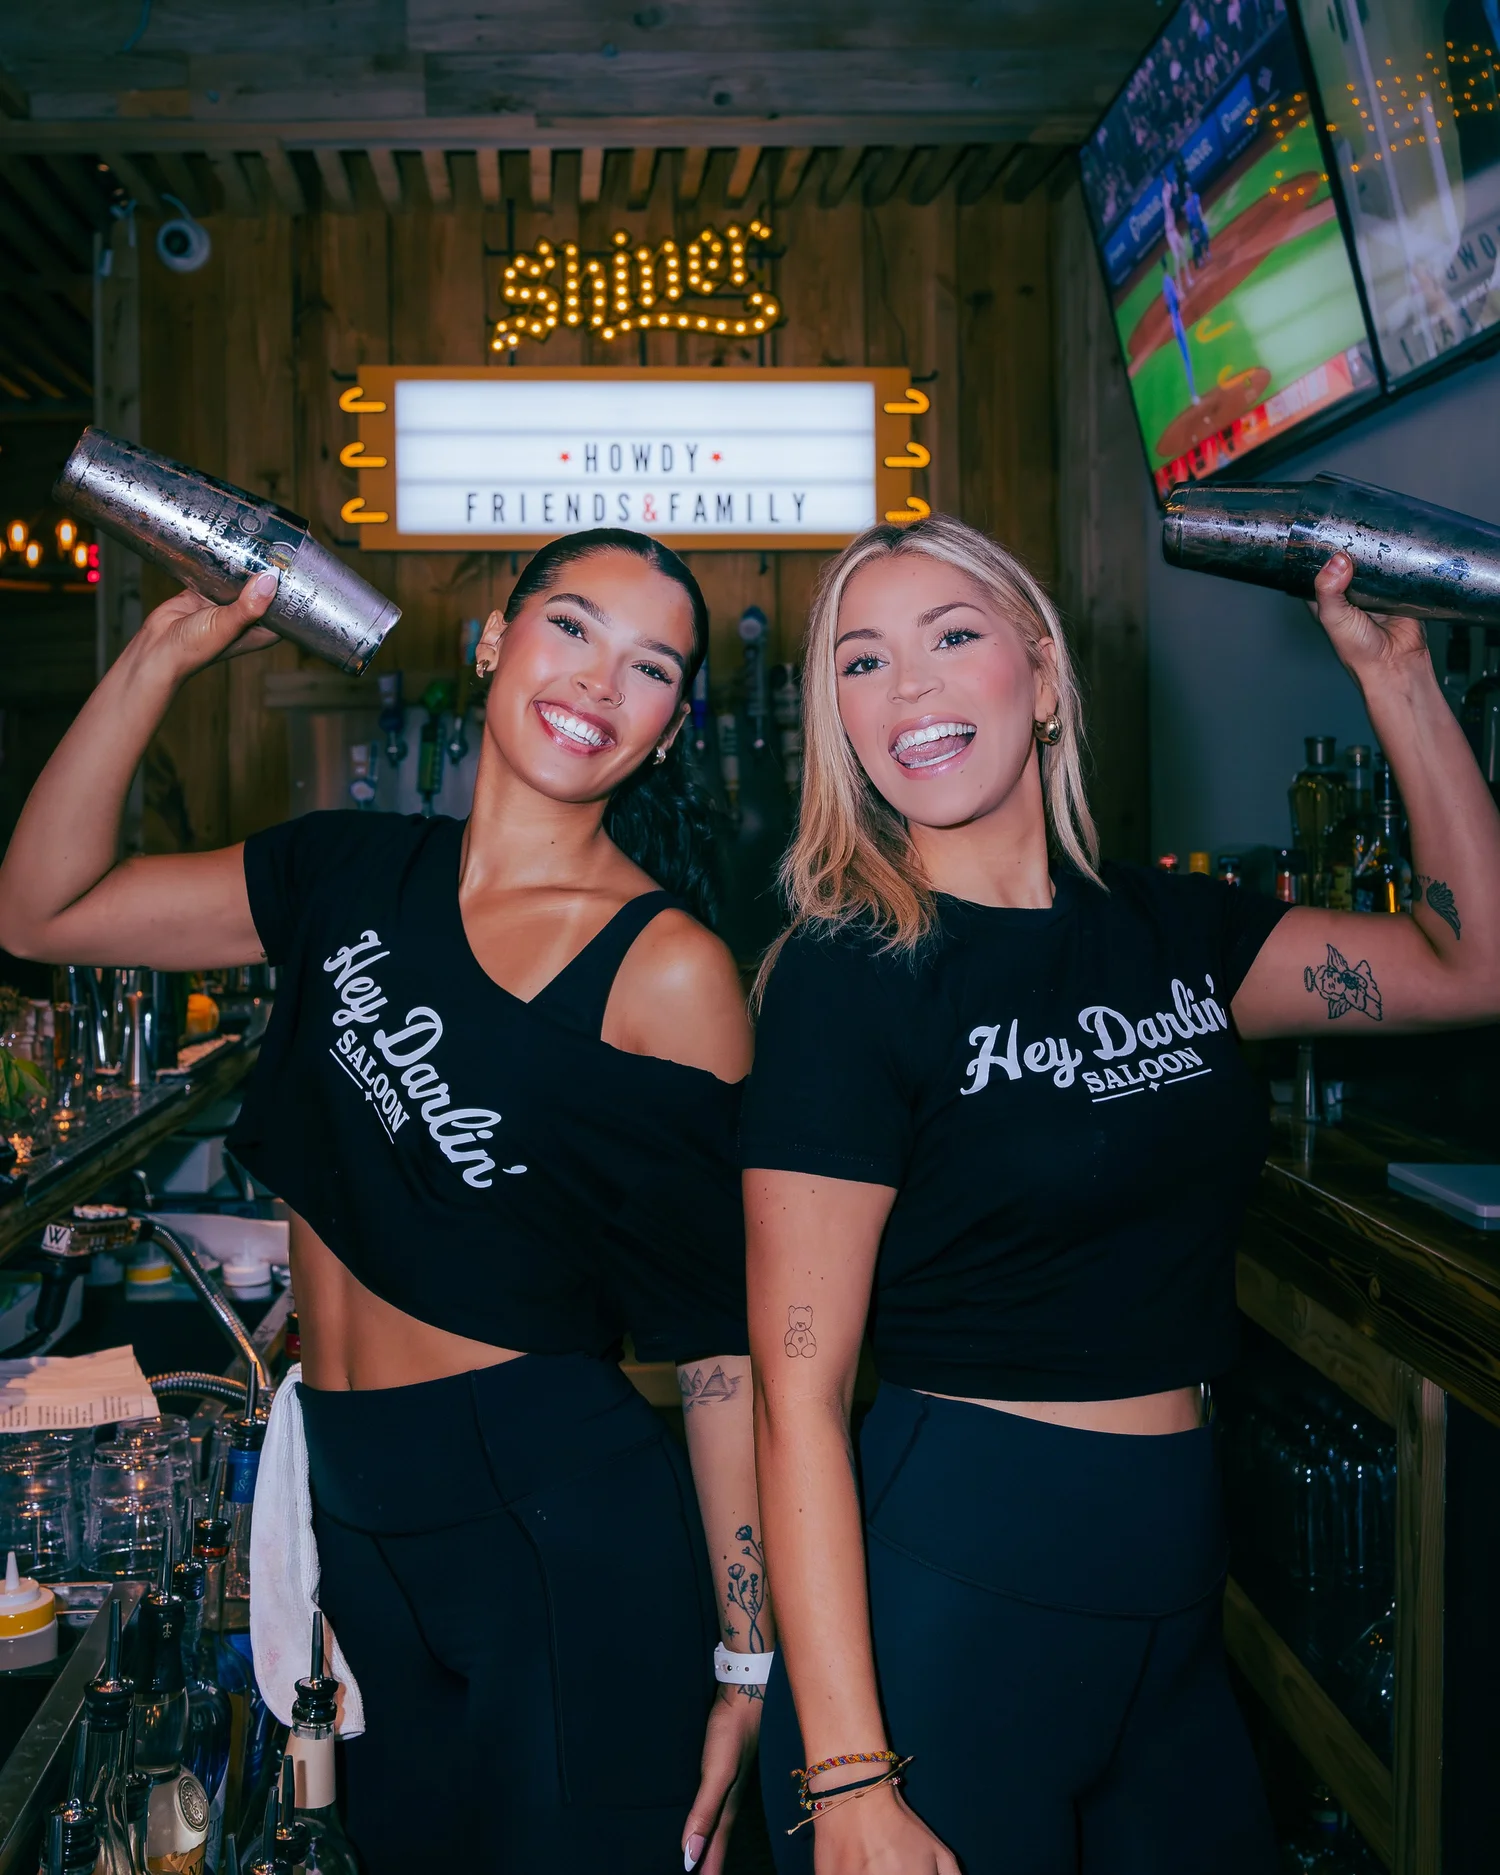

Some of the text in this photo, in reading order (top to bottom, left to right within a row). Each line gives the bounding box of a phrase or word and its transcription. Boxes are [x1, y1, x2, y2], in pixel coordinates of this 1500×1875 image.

[584, 442, 700, 474] HOWDY
[323, 929, 391, 1027] Hey
[335, 1029, 411, 1134] SALOON
[960, 1018, 1083, 1096] Hey
[1081, 1046, 1204, 1094] SALOON
